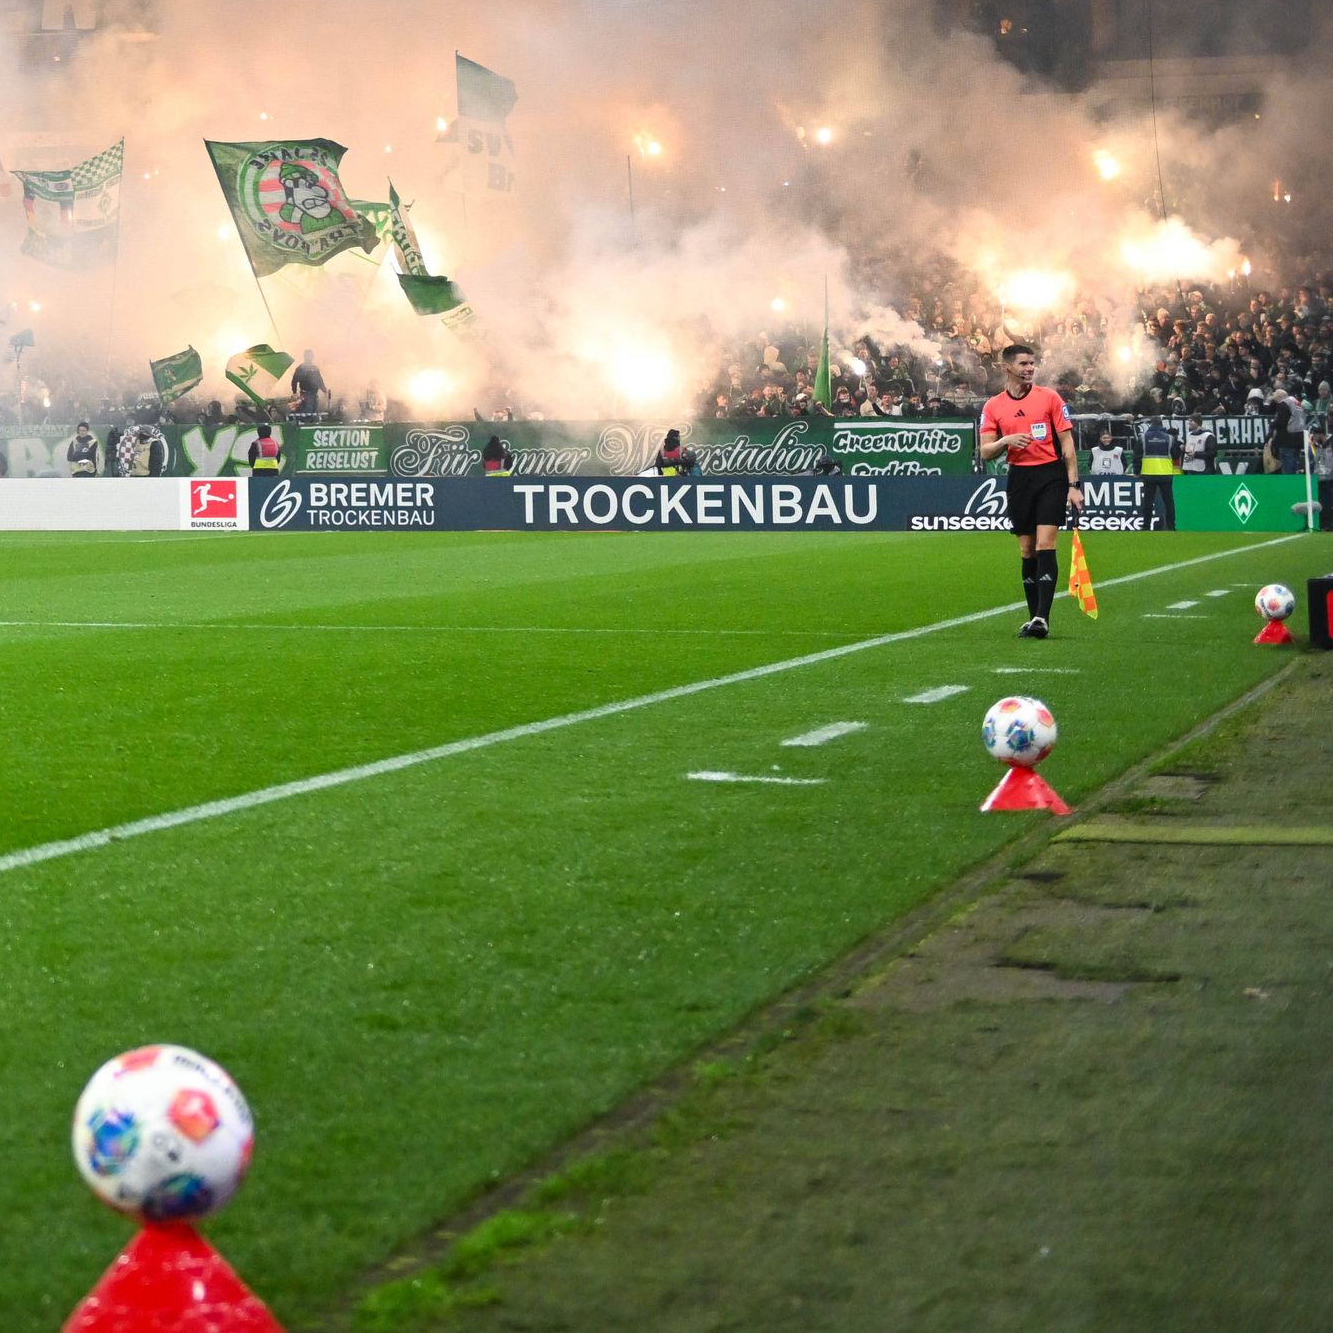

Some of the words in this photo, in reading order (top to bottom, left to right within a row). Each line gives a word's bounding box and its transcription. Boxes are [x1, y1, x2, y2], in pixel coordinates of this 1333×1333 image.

[312, 429, 370, 447] SEKTION
[833, 431, 961, 453] GreenWhite
[305, 449, 379, 469] REISELUST
[309, 483, 435, 508] BREMER
[513, 483, 878, 525] TROCKENBAU
[306, 509, 435, 526] TROCKENBAU
[911, 516, 1015, 532] sunseeke
